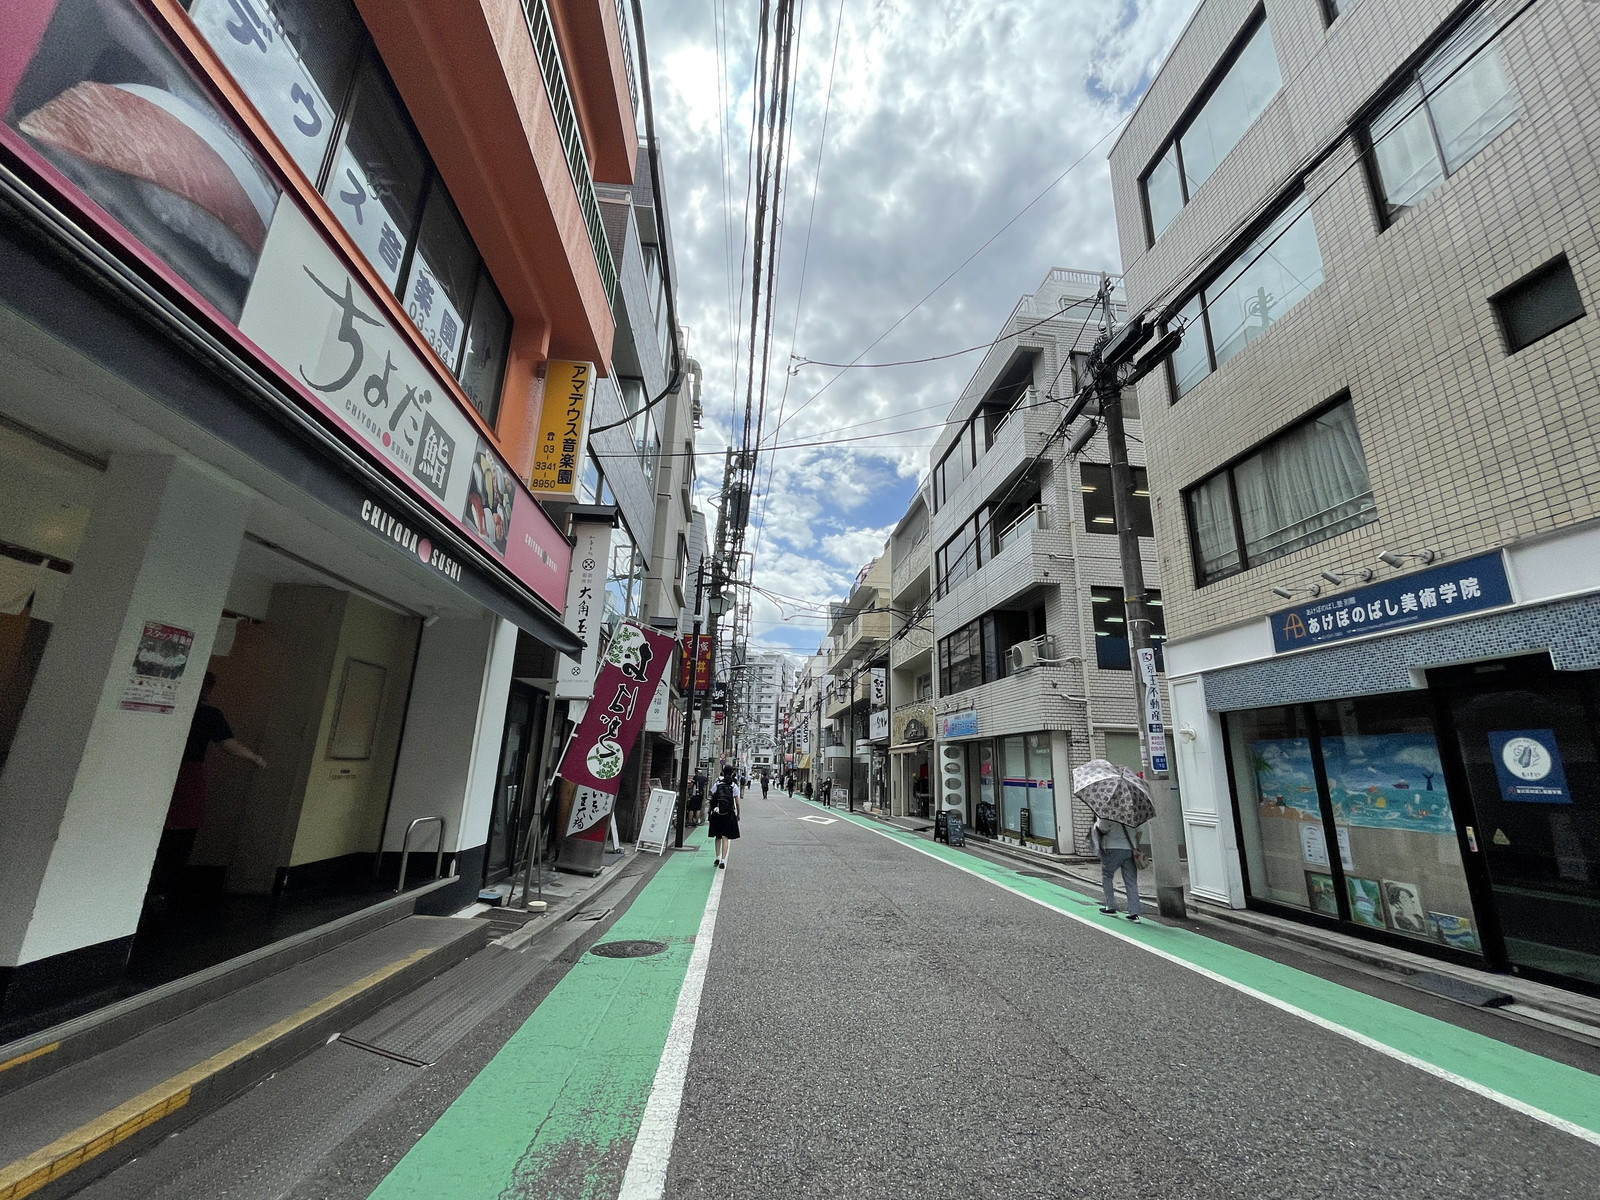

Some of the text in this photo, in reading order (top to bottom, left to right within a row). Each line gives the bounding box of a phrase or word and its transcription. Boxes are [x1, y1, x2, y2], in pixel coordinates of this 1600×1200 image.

[345, 399, 413, 467] CHIYODA SUSHI
[557, 365, 587, 485] アマデウス音楽園
[532, 478, 556, 488] 8950
[361, 499, 462, 582] CHIYODA SUSHI
[1308, 577, 1481, 634] あけぼのばし美術学院
[1146, 663, 1161, 721] 京王不動産
